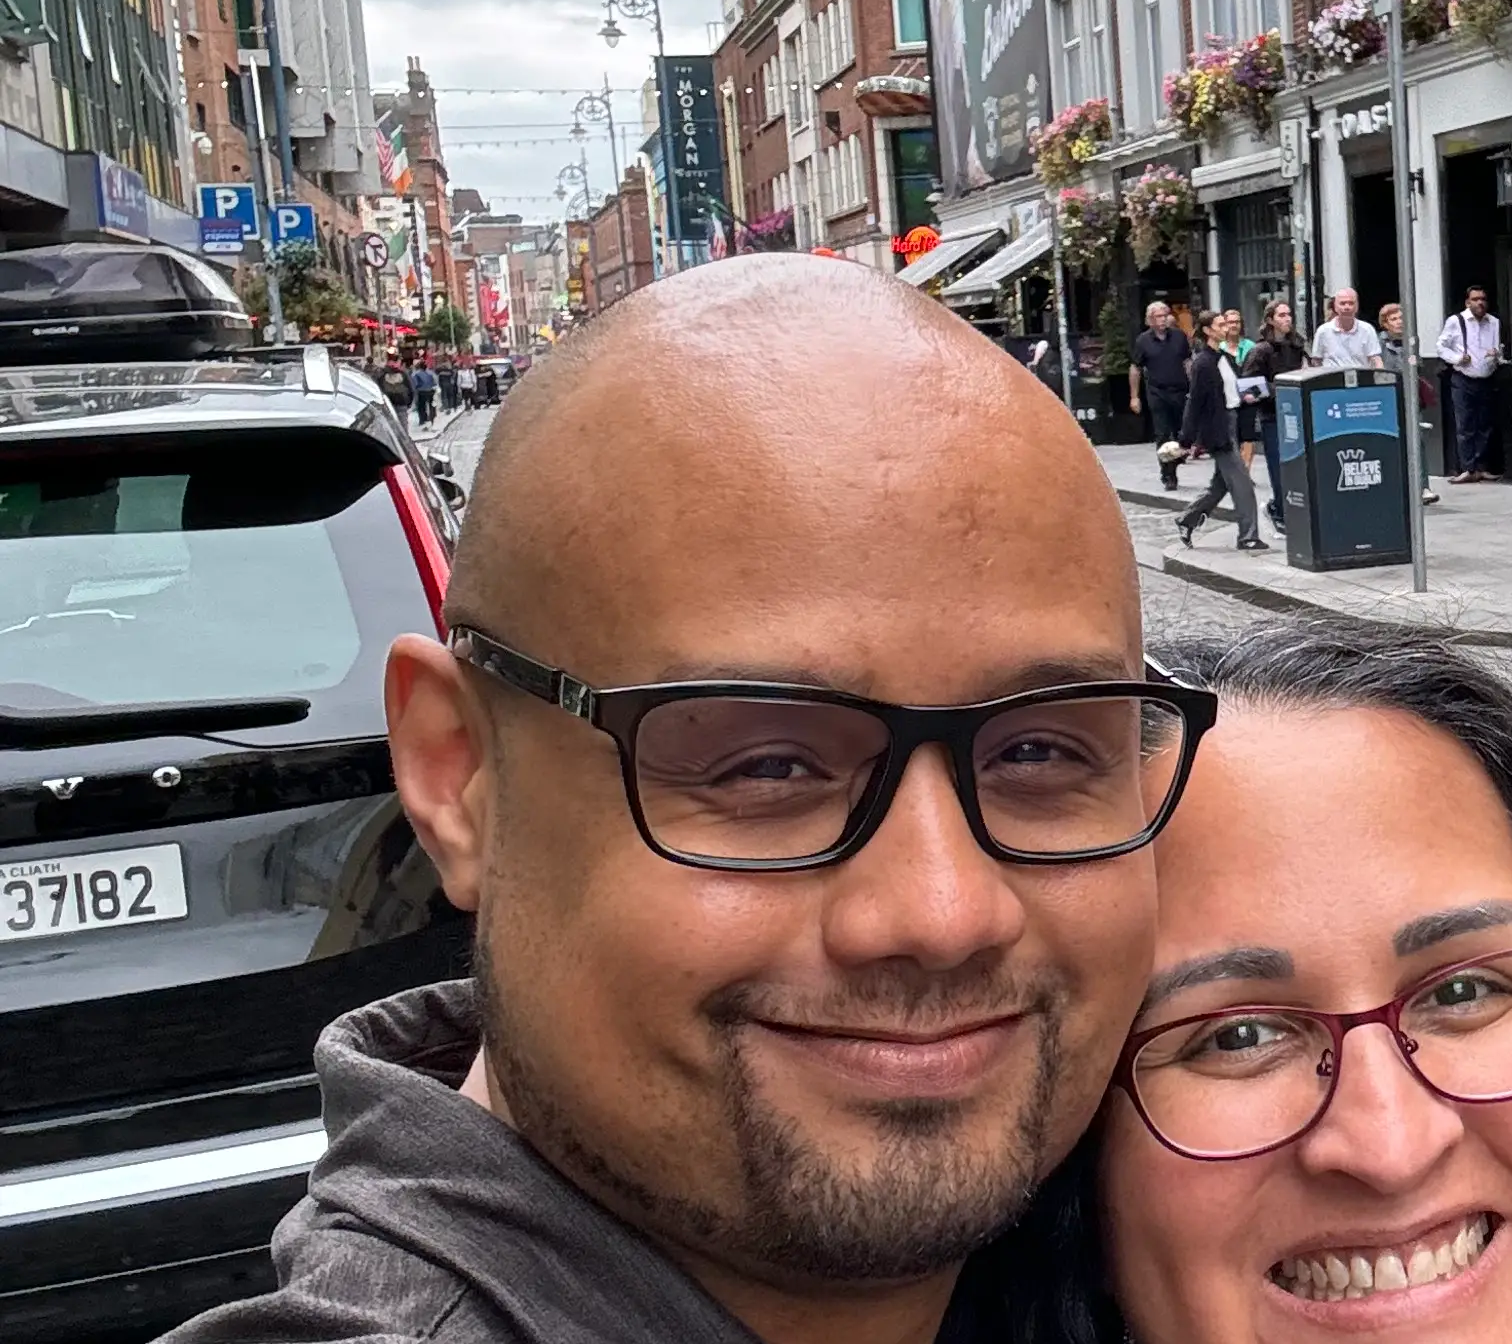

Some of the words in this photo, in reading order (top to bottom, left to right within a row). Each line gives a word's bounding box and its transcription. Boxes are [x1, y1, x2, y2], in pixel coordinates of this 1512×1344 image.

[679, 79, 699, 166] MORGAN
[215, 188, 240, 218] P
[278, 208, 301, 238] P
[1344, 460, 1381, 475] BELIEVE
[10, 862, 61, 878] CLIATH
[3, 866, 156, 932] 37182
